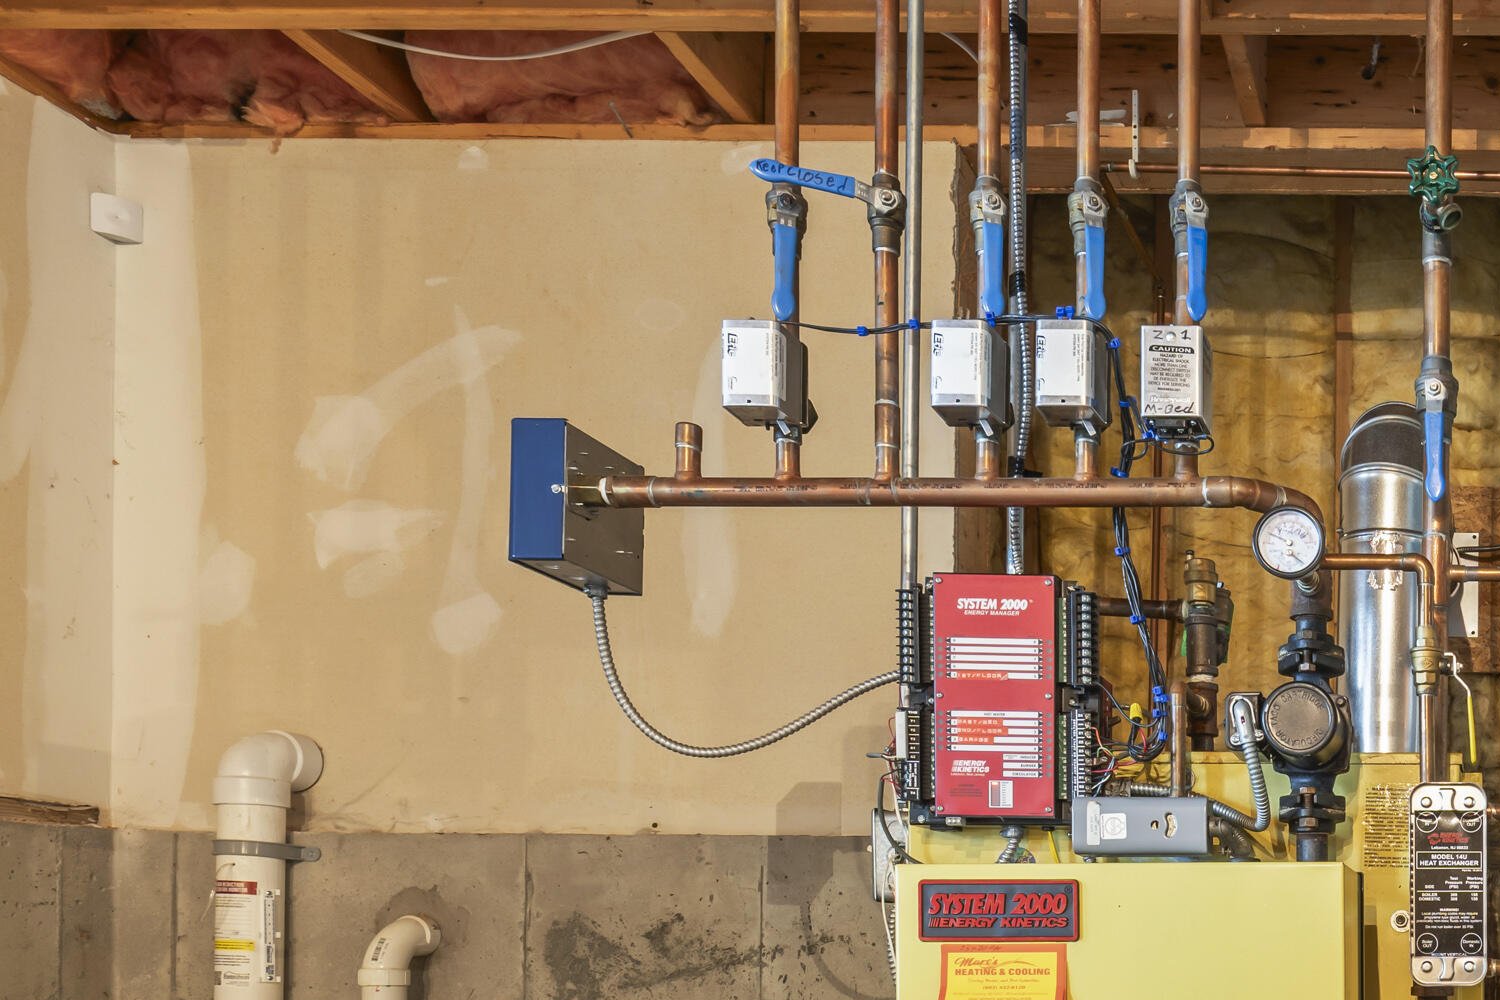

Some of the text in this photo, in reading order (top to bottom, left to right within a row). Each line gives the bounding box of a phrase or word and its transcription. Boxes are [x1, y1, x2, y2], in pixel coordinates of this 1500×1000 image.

[1152, 345, 1192, 354] CAUTION
[957, 597, 1028, 611] SYSTEM 2000
[928, 892, 1068, 916] SYSTEM 2000
[938, 917, 1069, 928] ENERGY KINETICS
[955, 968, 1051, 976] HEATING & COOLING
